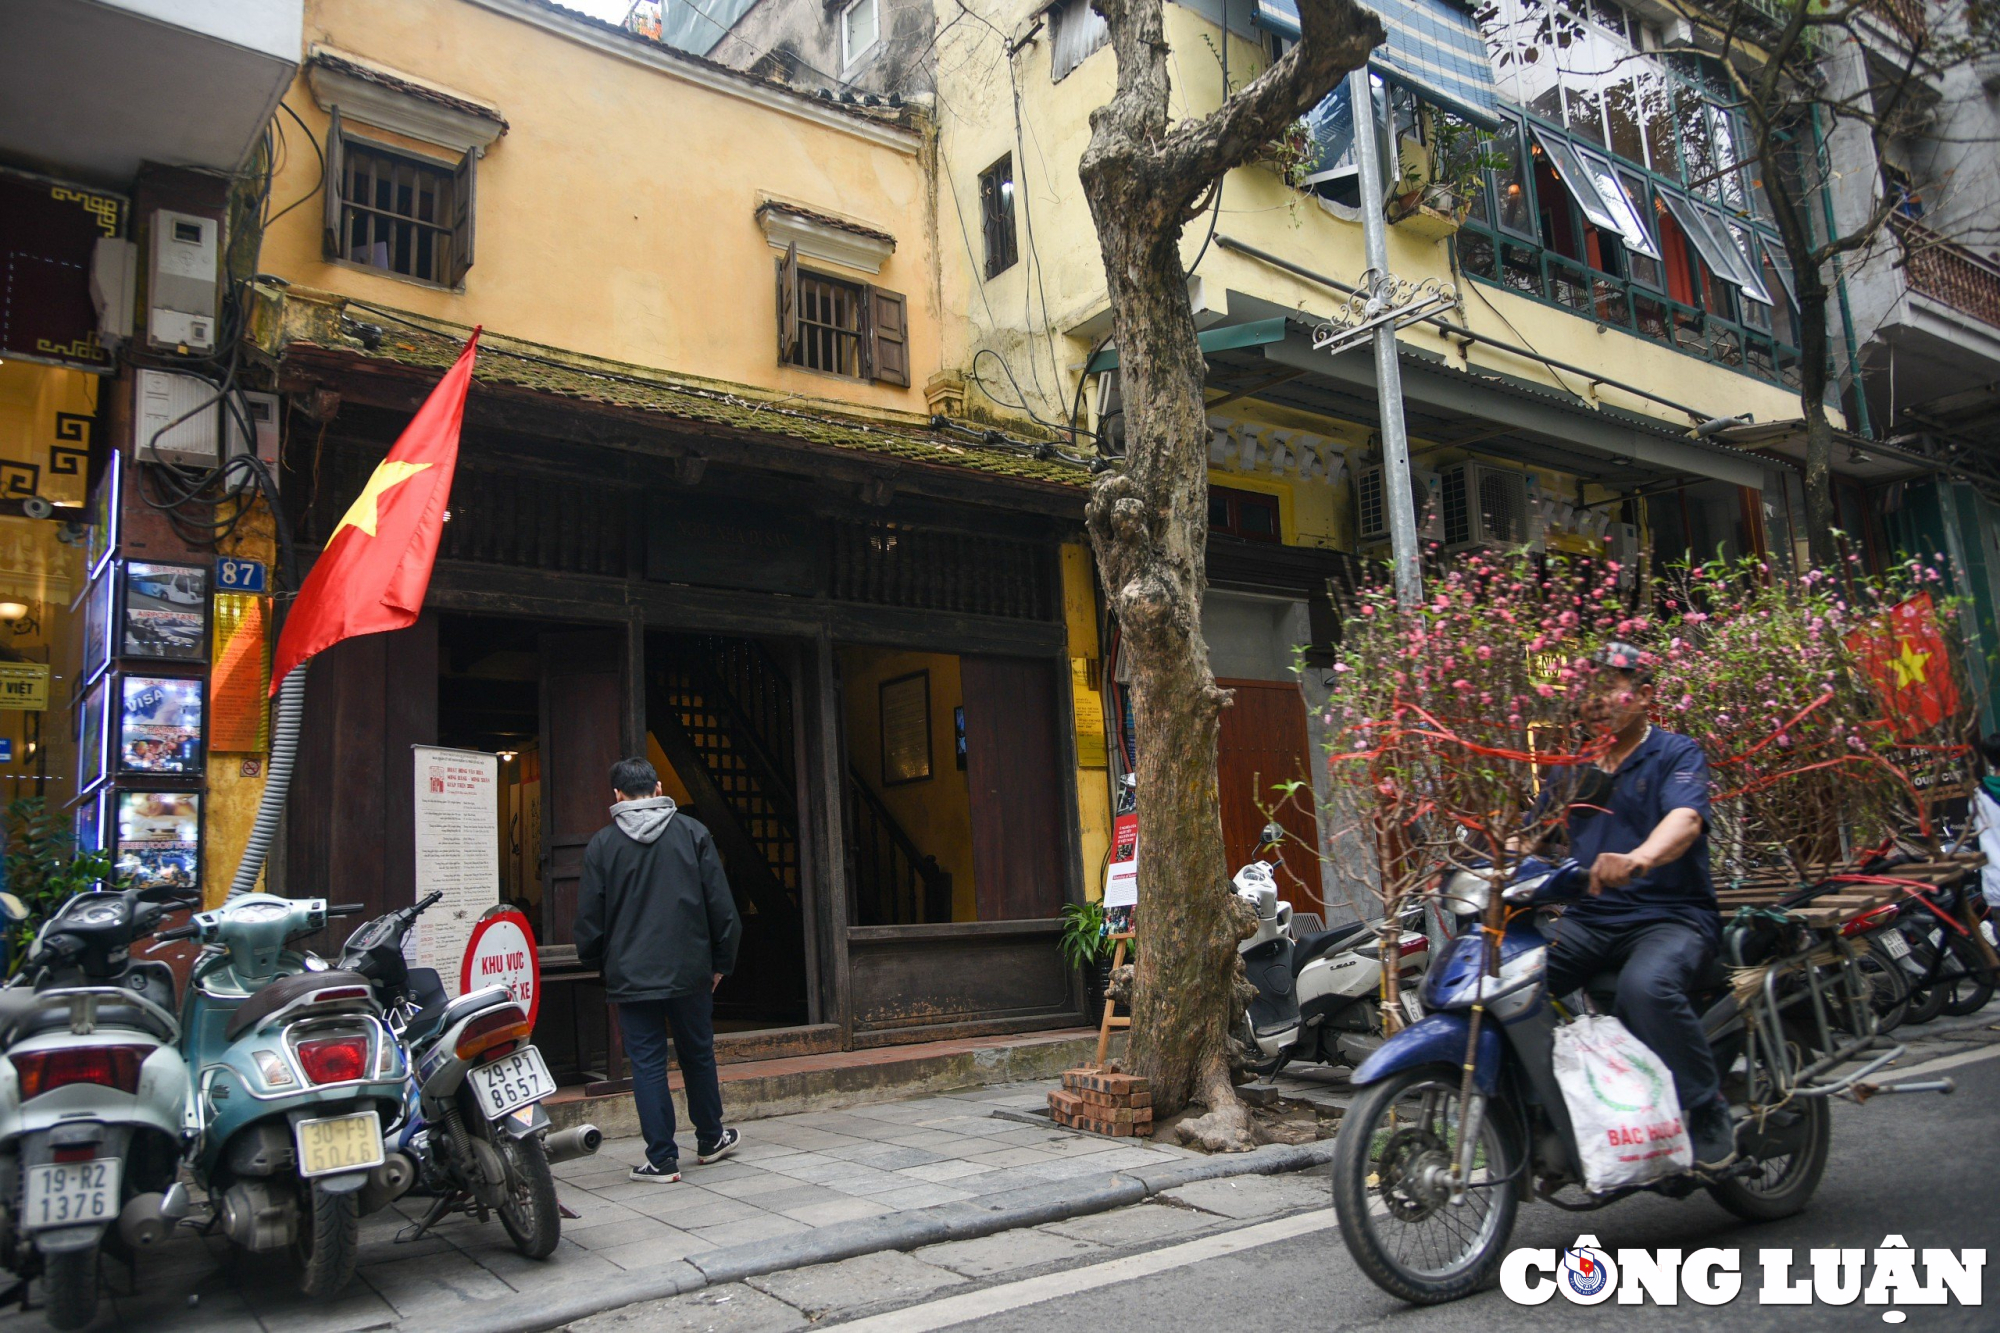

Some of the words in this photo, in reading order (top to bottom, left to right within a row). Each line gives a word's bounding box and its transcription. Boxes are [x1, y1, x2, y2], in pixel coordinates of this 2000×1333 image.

[221, 561, 254, 586] 87
[7, 681, 34, 697] VIỆT
[126, 689, 165, 712] VISA
[482, 955, 503, 975] KHU
[506, 950, 524, 974] VỰC
[520, 982, 530, 1000] XE
[482, 1056, 534, 1087] 29-P1
[491, 1074, 539, 1109] 8657
[311, 1117, 368, 1145] 30-F9
[313, 1142, 371, 1169] 5046
[42, 1165, 106, 1193] 19-R2
[41, 1192, 105, 1222] 1376
